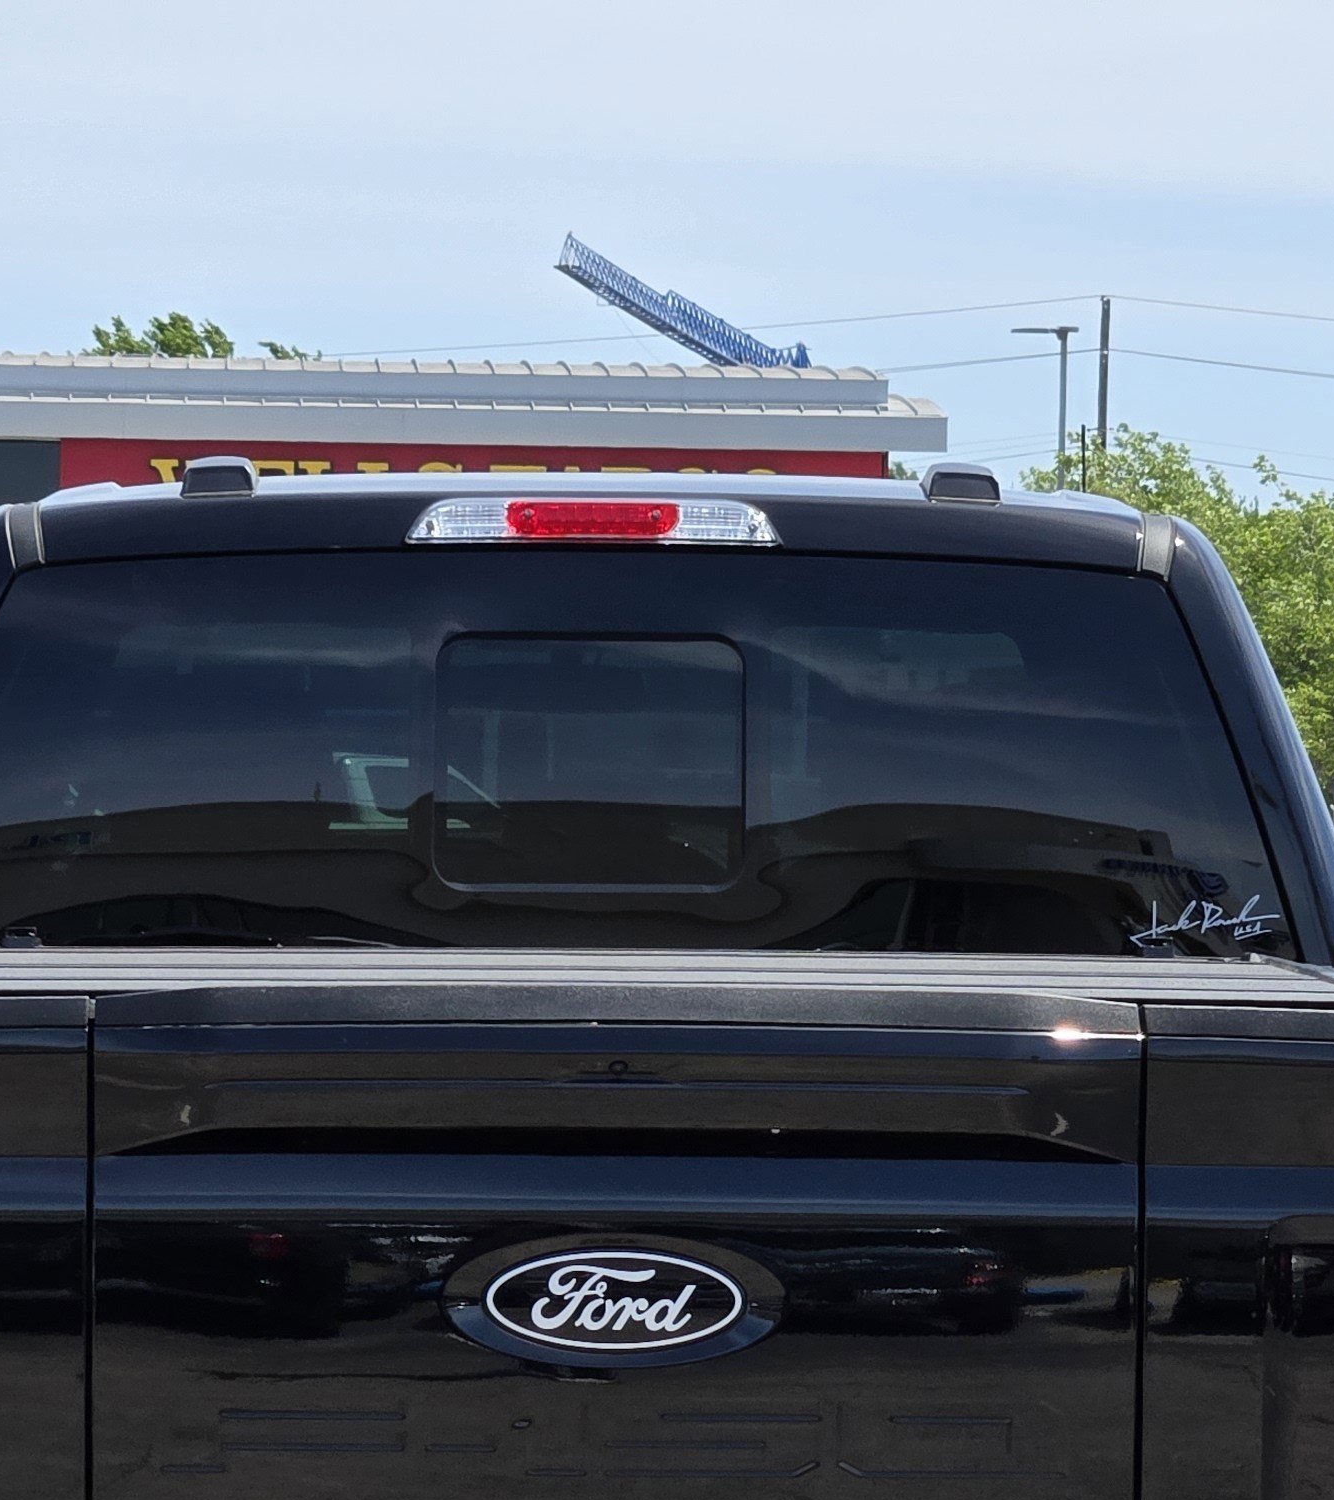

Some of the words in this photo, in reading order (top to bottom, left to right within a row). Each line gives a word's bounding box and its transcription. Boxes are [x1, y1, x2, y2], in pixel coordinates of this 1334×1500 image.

[1130, 900, 1201, 947] Jack
[1234, 922, 1262, 937] USA
[530, 1264, 697, 1332] Ford
